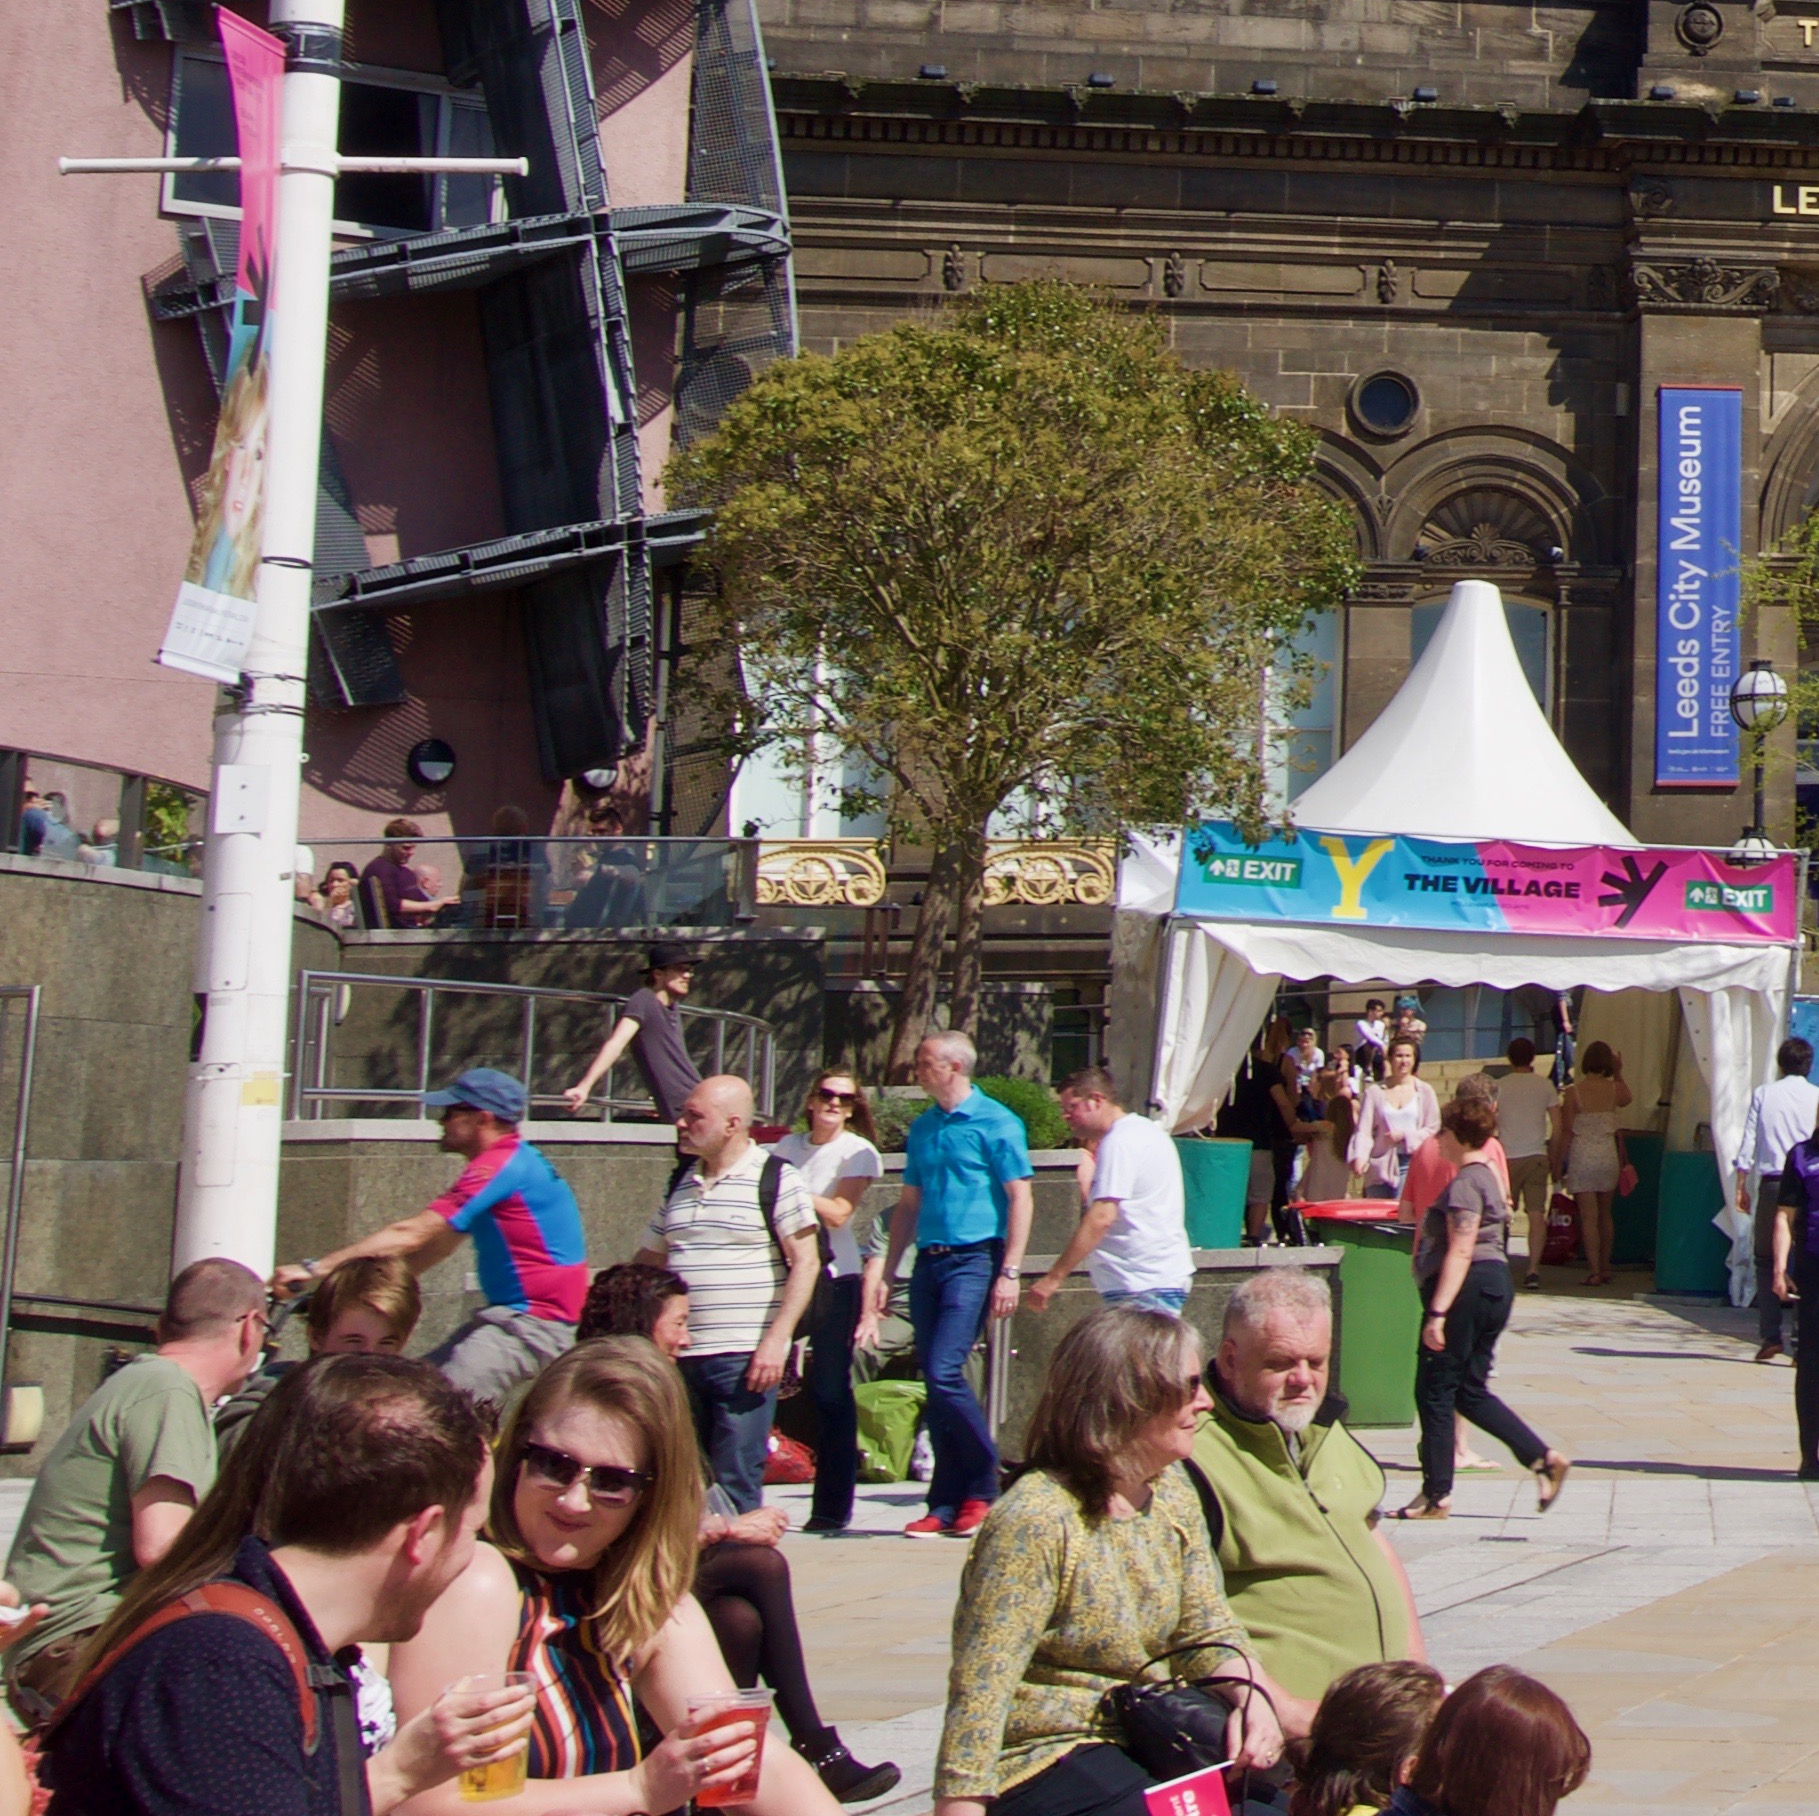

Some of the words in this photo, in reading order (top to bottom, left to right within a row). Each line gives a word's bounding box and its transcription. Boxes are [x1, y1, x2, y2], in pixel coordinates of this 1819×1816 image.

[1670, 406, 1702, 551] Museum
[1668, 559, 1709, 630] City
[1711, 605, 1732, 678] ENTRY
[1667, 639, 1700, 737] Leeds
[1710, 684, 1731, 737] FREE
[1243, 859, 1297, 882] EXIT
[1318, 835, 1396, 920] Y
[1404, 873, 1458, 893] THE
[1462, 876, 1581, 899] VILLAGE
[1421, 855, 1460, 865] THANK
[1462, 857, 1485, 866] YOU
[1487, 859, 1509, 868] FOR
[1511, 860, 1557, 870] COMING
[1559, 862, 1575, 871] TO
[1722, 888, 1767, 908] EXIT
